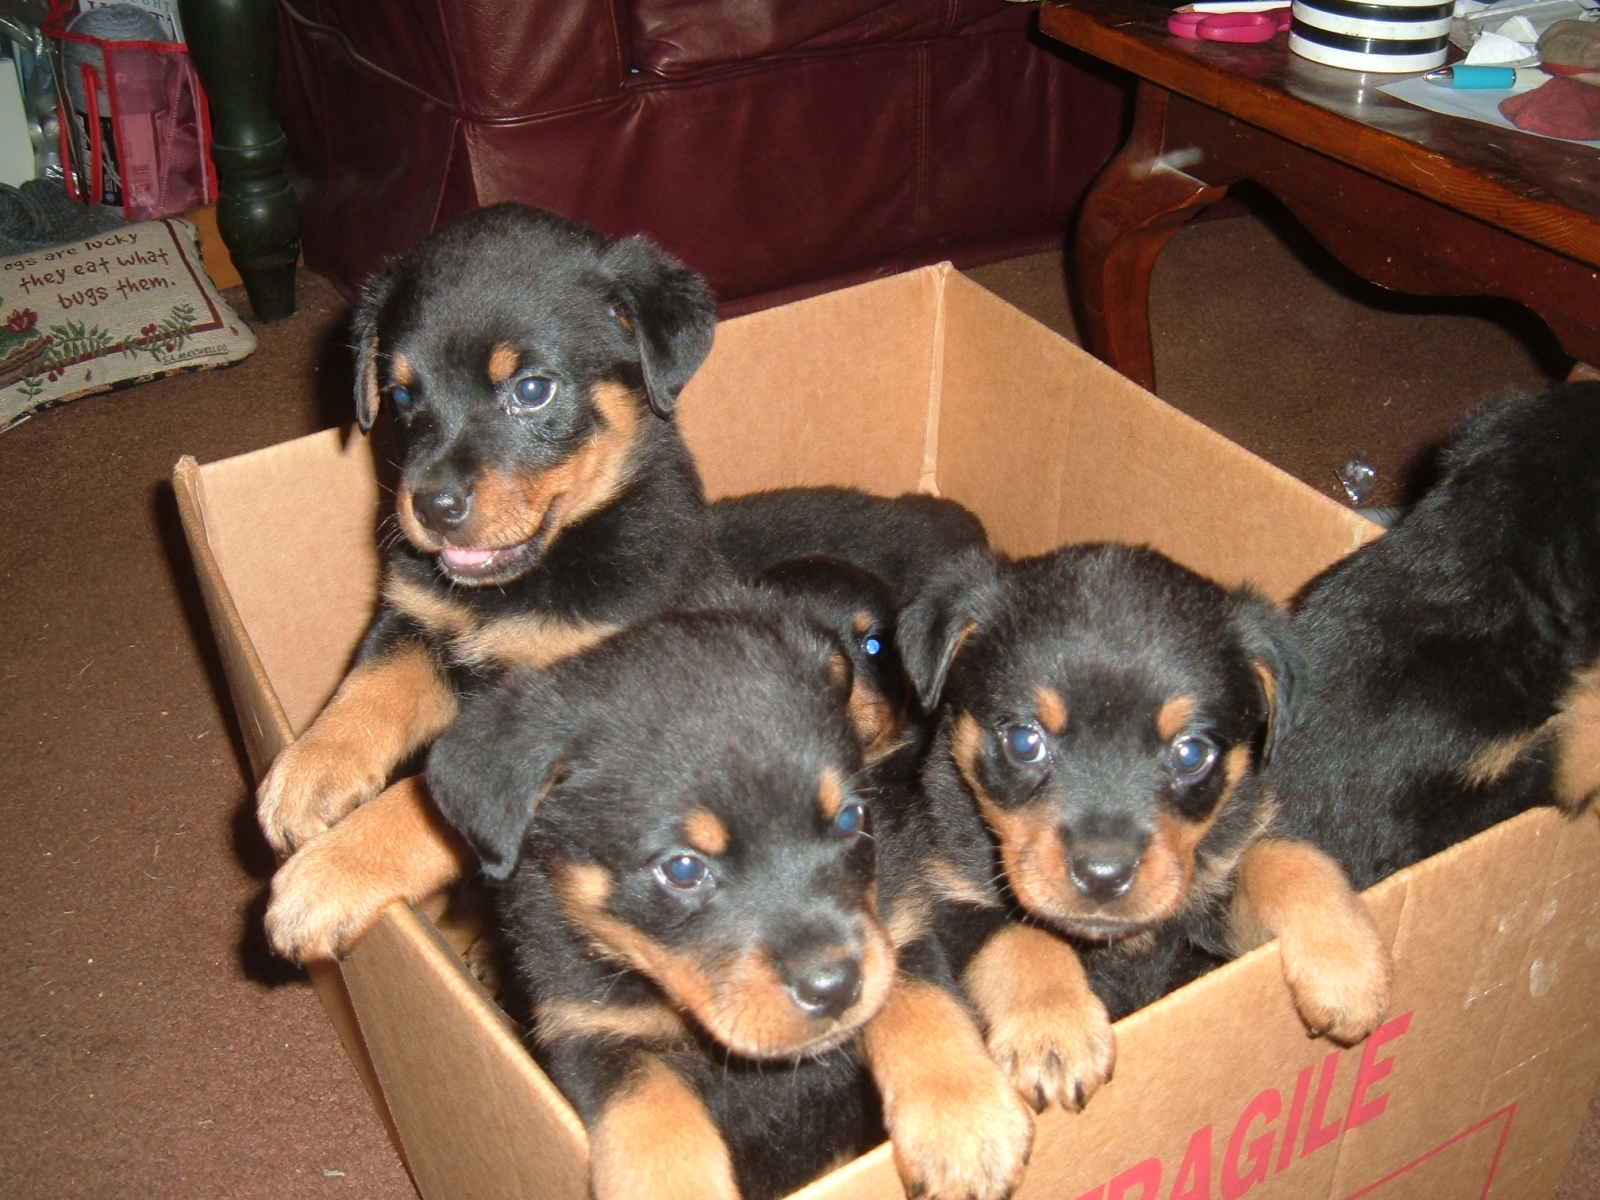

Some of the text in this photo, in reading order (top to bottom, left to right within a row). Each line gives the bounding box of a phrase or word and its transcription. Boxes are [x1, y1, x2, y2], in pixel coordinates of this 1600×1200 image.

[0, 232, 138, 272] ogs are lucky
[19, 247, 169, 294] they eat what
[57, 276, 176, 309] bugs them.
[1075, 1009, 1415, 1200] AGILE
